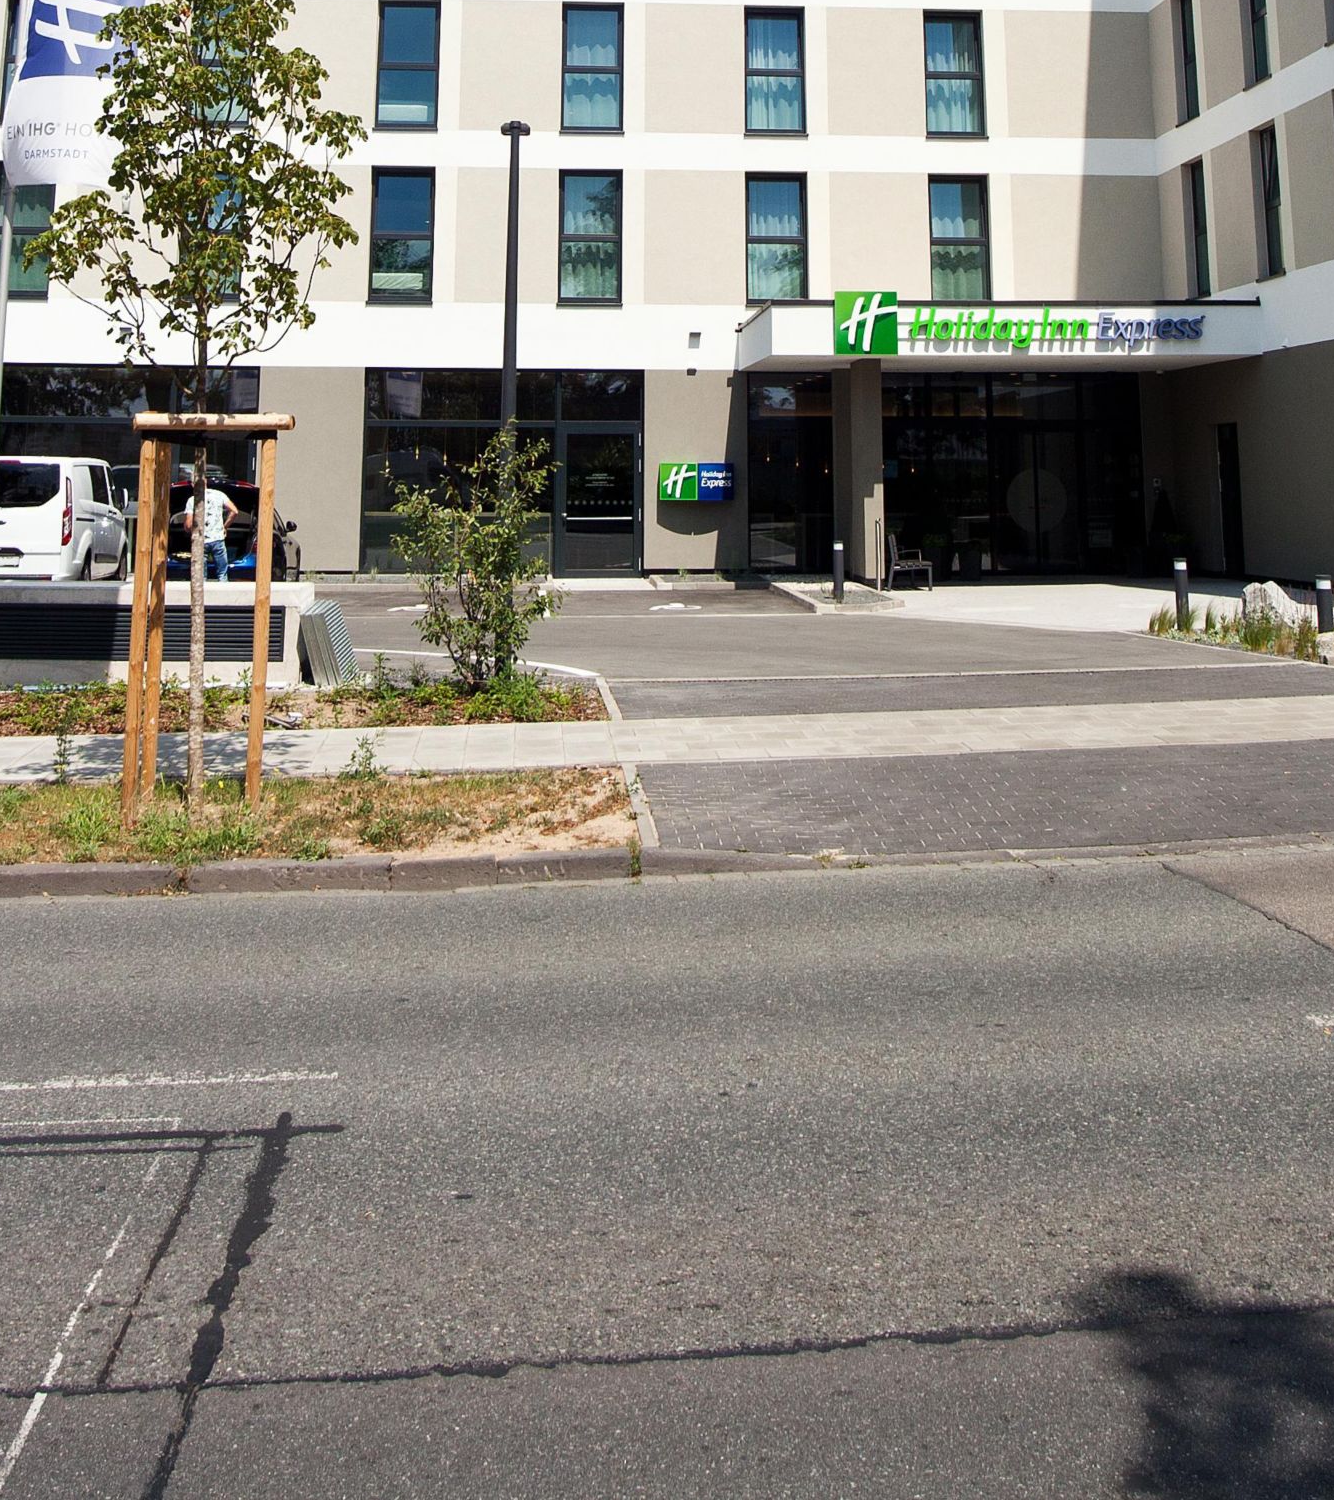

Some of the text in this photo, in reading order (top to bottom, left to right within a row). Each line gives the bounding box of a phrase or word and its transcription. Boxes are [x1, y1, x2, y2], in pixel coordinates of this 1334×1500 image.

[6, 123, 25, 140] EIN
[28, 121, 56, 137] IHG
[24, 148, 90, 160] DARMSTADT
[909, 307, 1204, 348] Holiday Inn Express
[701, 477, 732, 489] Express
